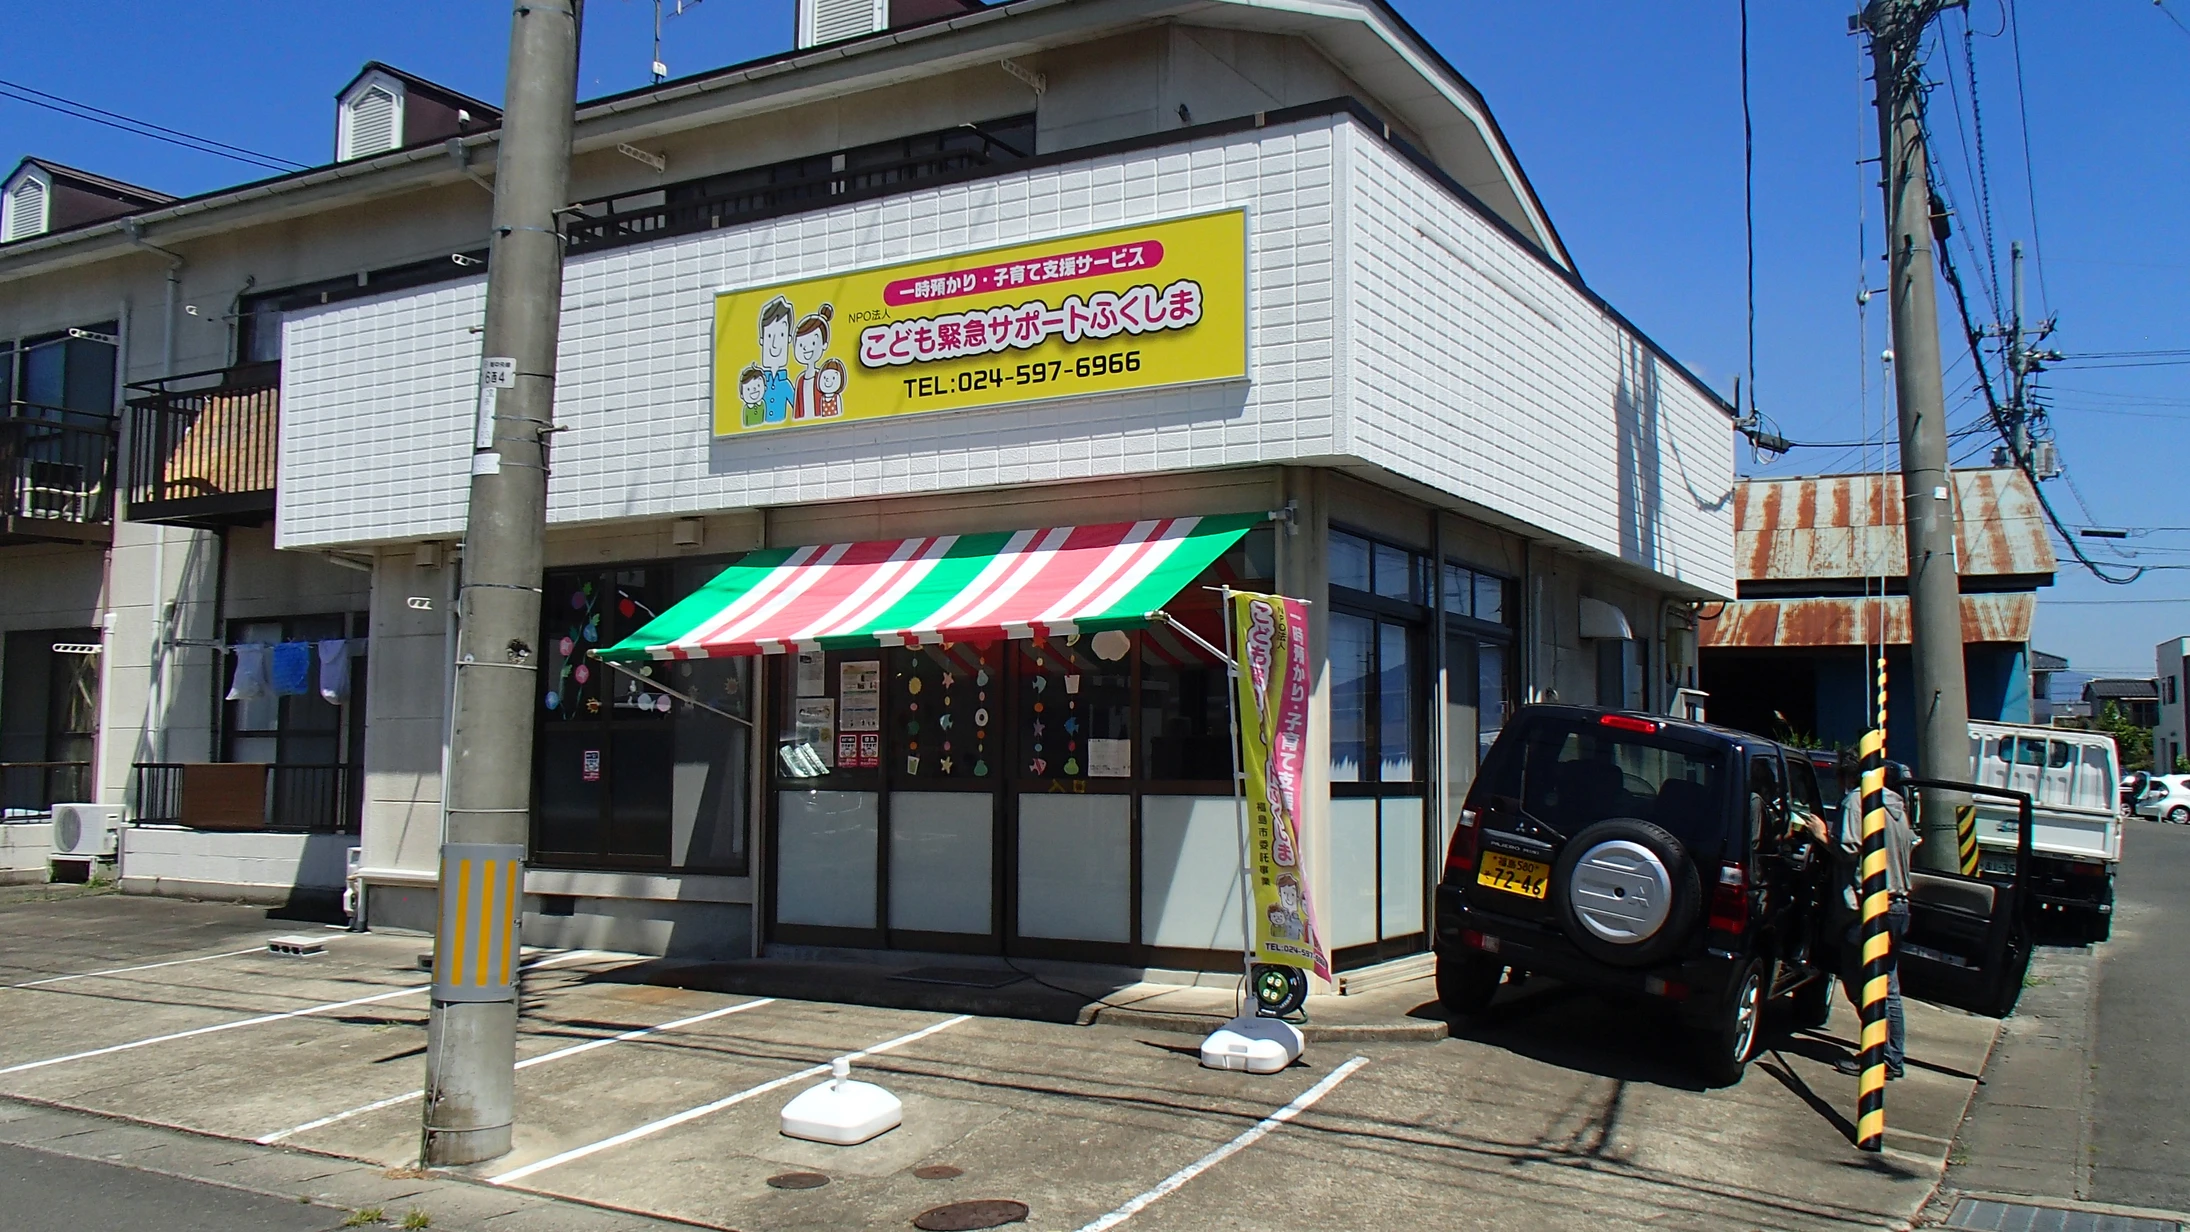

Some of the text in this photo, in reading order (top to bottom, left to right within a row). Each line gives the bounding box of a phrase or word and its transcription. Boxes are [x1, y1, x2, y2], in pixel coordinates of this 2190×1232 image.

[898, 246, 1146, 298] 一時預かり・子育て支援サービス
[848, 306, 892, 324] NPO法人
[865, 288, 1195, 361] こども緊急サポートふくしま
[903, 350, 1142, 399] TEL:024-597-6966
[1048, 778, 1087, 793] 入口
[1256, 801, 1271, 887] 福島市委託事業
[1494, 867, 1543, 894] 72-46
